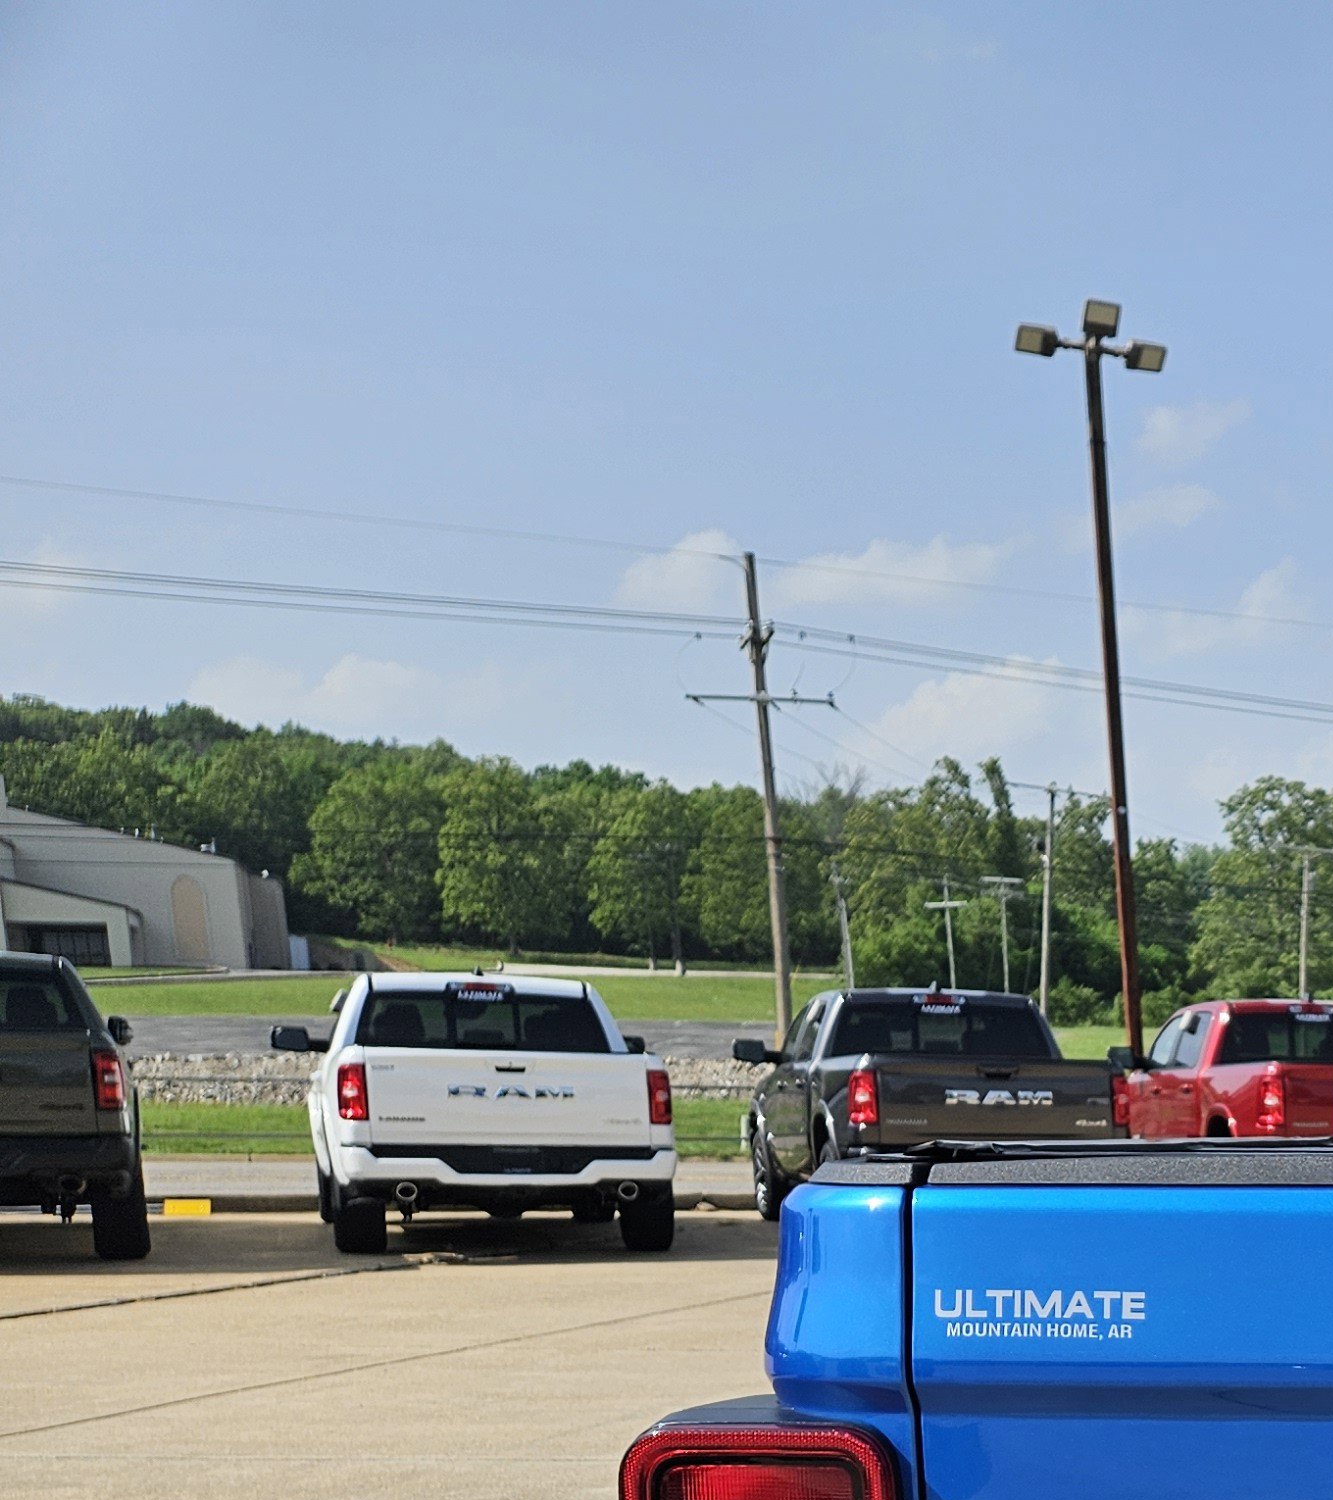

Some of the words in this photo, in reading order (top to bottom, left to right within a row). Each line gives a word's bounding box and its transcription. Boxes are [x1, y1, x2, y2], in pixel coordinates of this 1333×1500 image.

[447, 1083, 575, 1099] RAM
[944, 1089, 1053, 1105] RAM
[934, 1289, 1146, 1320] ULTIMATE
[946, 1322, 1041, 1338] MOUNTAIN
[1046, 1323, 1104, 1341] HOME,
[1108, 1324, 1133, 1339] AR
